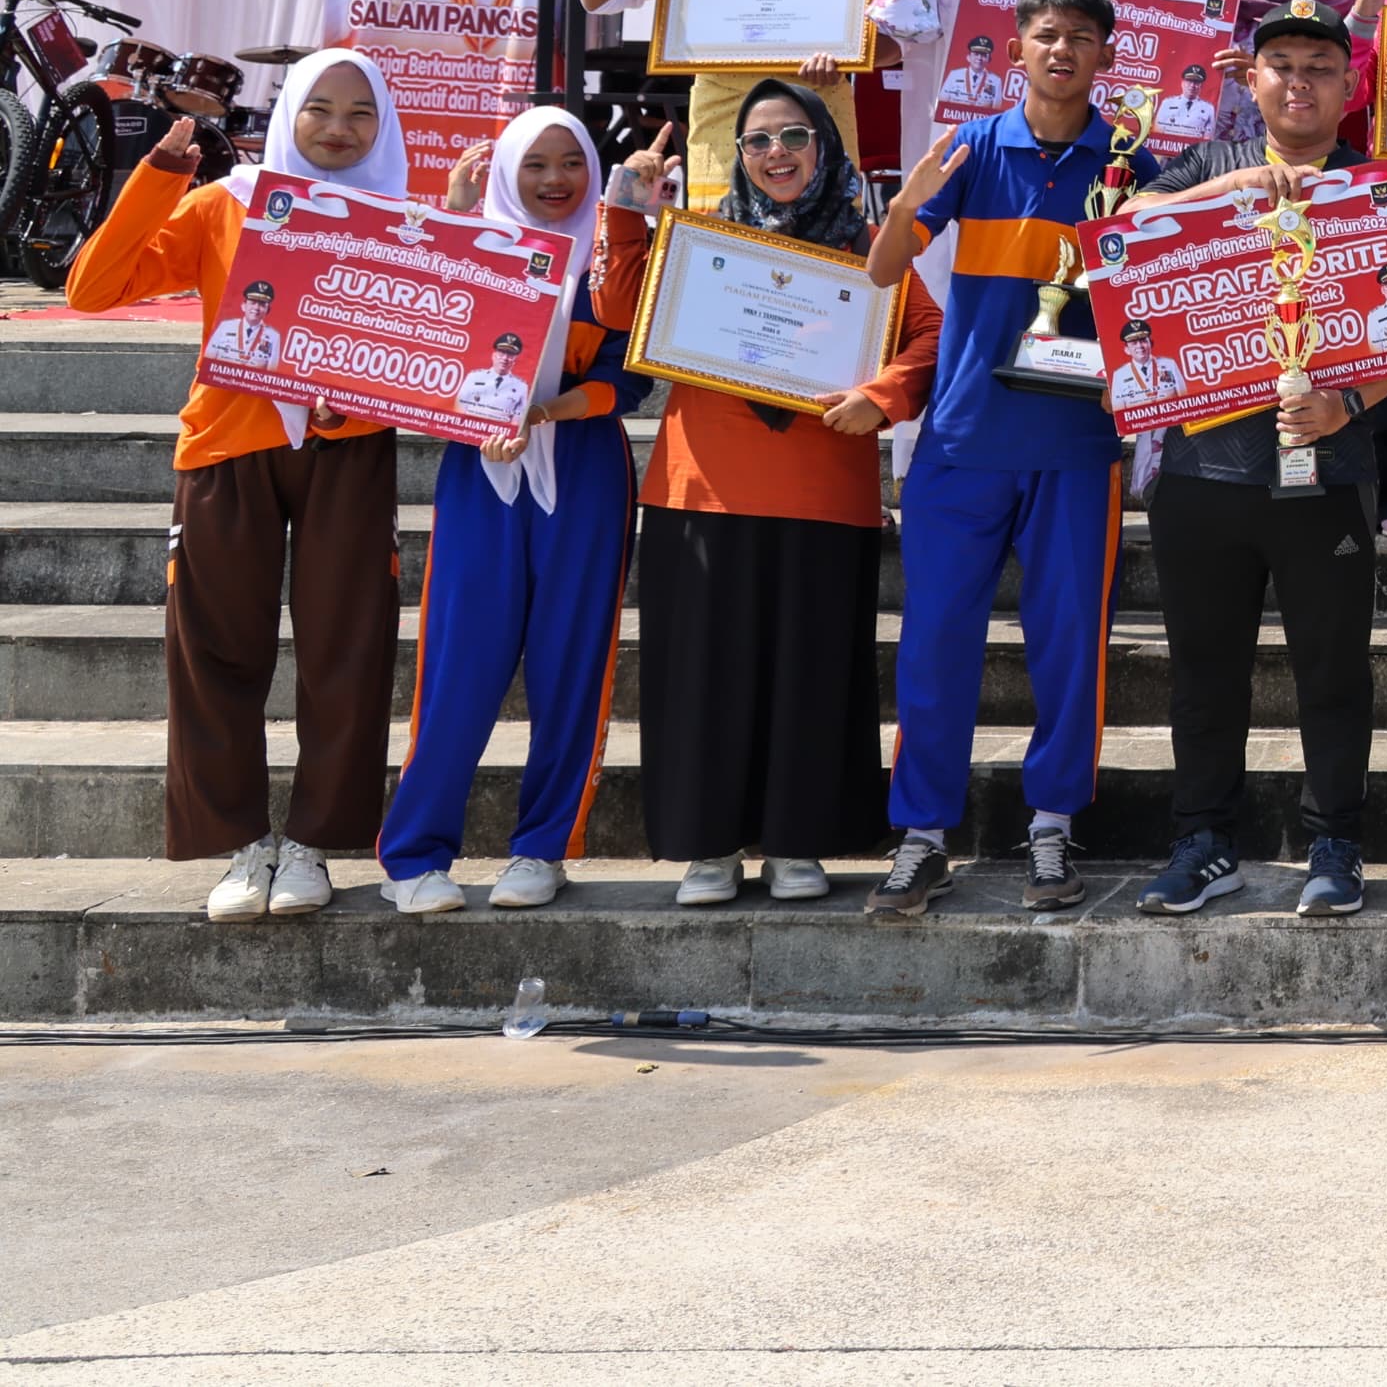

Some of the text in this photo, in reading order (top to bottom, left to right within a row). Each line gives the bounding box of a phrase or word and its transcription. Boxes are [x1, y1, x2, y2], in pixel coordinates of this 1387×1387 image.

[350, 0, 438, 31] SALAM
[1123, 6, 1215, 38] Kepri Tahun 2025
[1142, 35, 1156, 59] 1
[409, 52, 500, 79] Berkarakter
[1114, 65, 1156, 80] Pantun
[449, 91, 477, 109] dan
[943, 109, 969, 119] BADAN
[406, 131, 447, 149] Sirih,
[414, 154, 421, 166] 1
[263, 232, 538, 299] Gebyar Pelajar Pancasila Kepri Tahun 2025
[1112, 260, 1162, 285] Gebyar
[1162, 242, 1210, 271] Pelajar
[1319, 219, 1361, 238] Tahun
[320, 270, 470, 320] JUARA 2
[1133, 274, 1238, 314] JUARA
[303, 301, 465, 347] Lomba Berbalas Pantun
[1194, 306, 1241, 329] Lomba
[288, 332, 459, 393] Rp.3.000.000
[210, 364, 510, 435] BADAN KESATUAN BANGSA DAN POLITIK PROVINSI KEPULAUAN RIAU
[1124, 408, 1157, 421] BADAN
[1160, 395, 1208, 413] KESATUAN
[1210, 387, 1249, 403] BANGSA
[1251, 383, 1270, 394] DAN
[1311, 363, 1353, 380] PROVINSI
